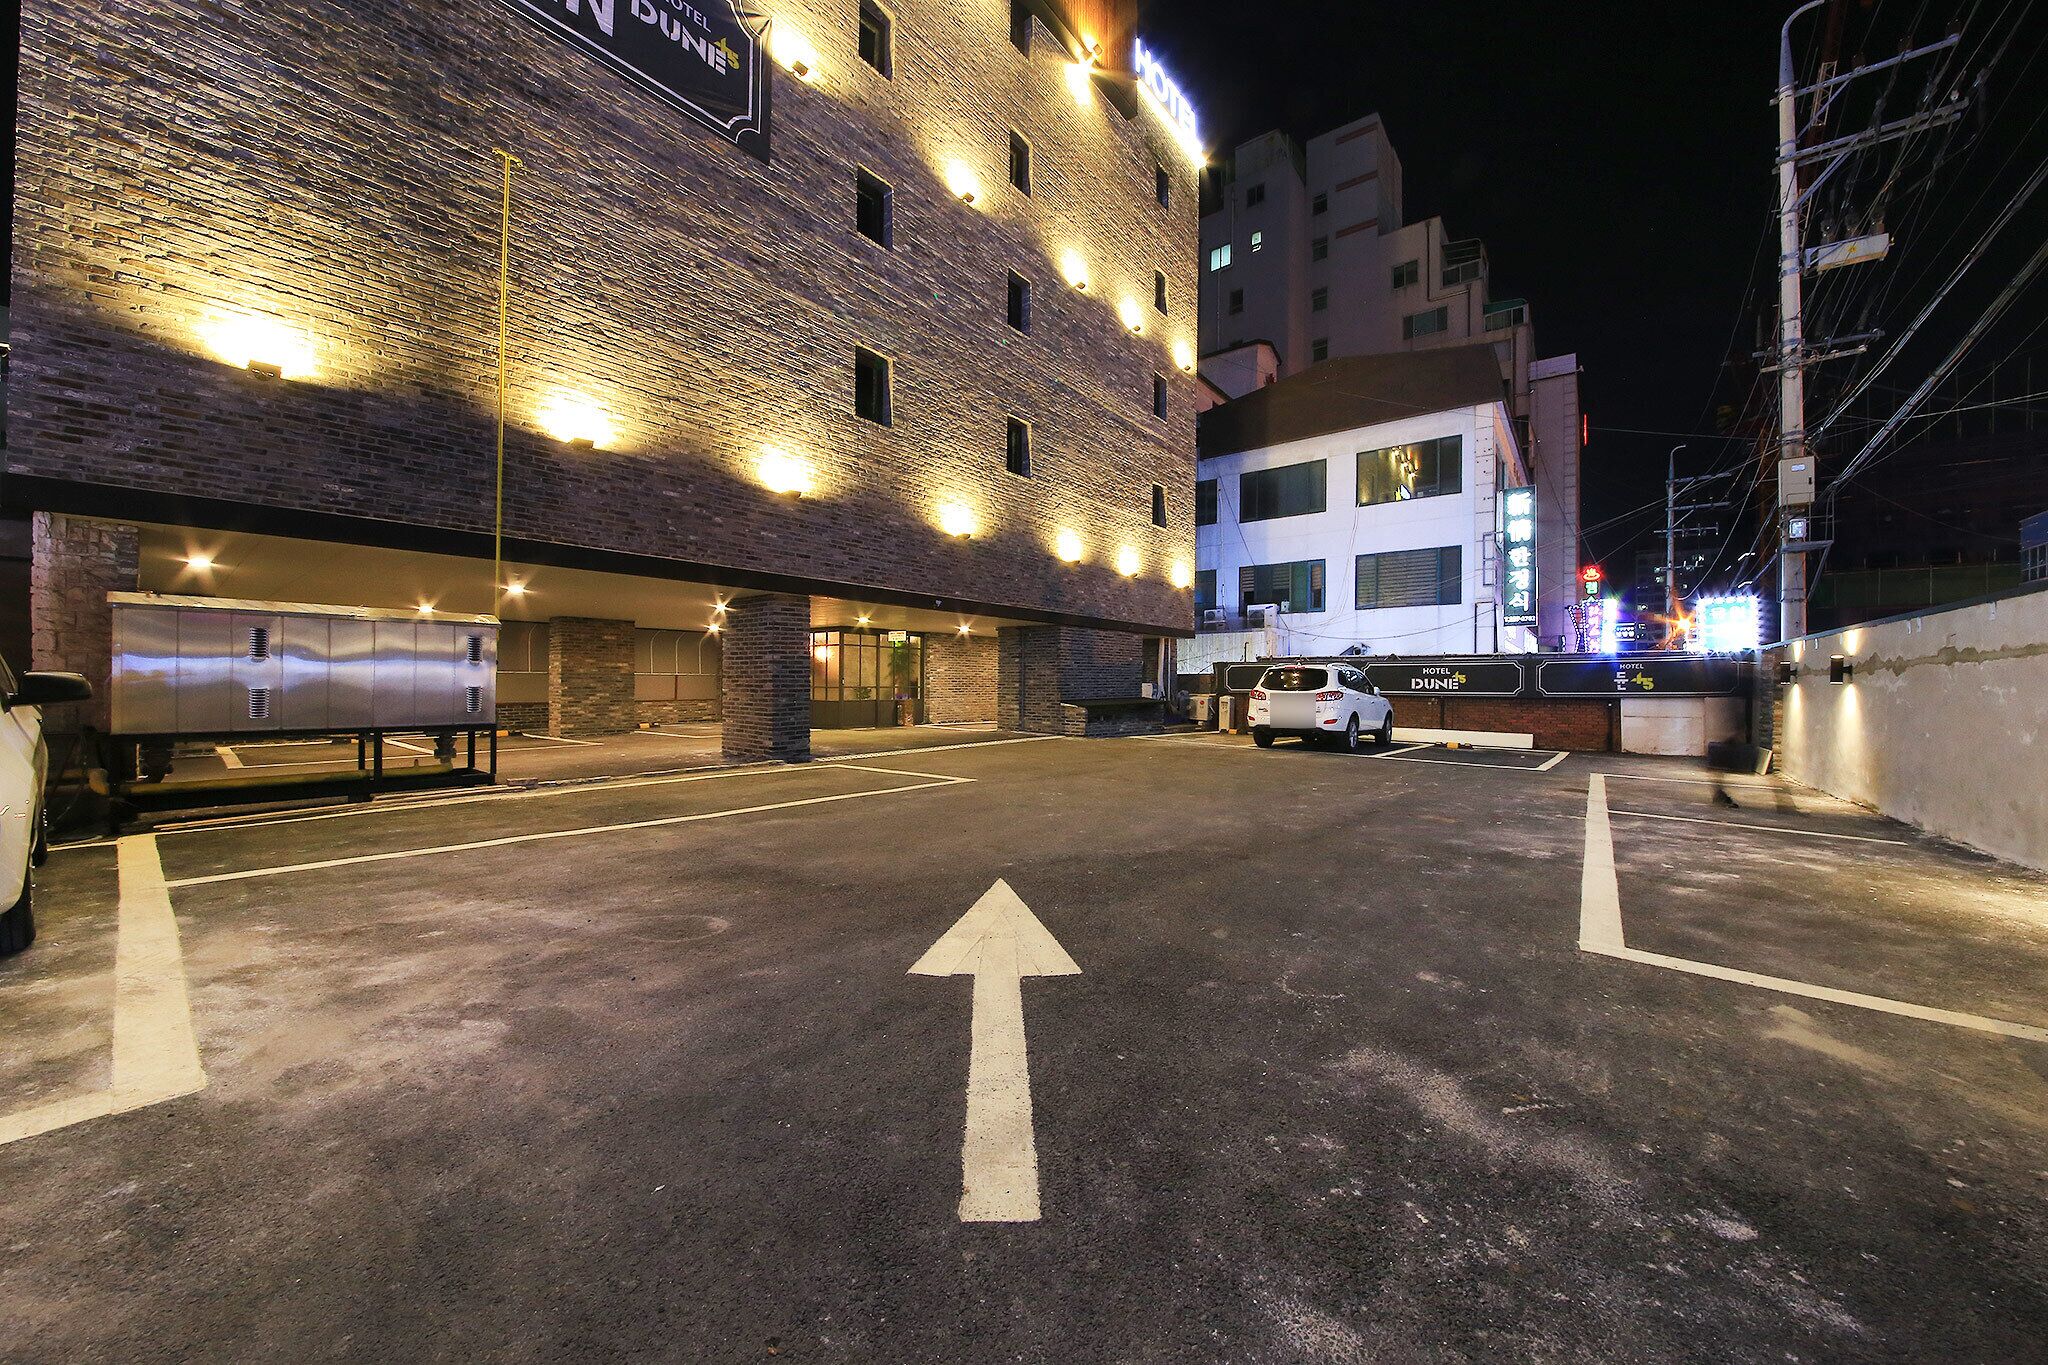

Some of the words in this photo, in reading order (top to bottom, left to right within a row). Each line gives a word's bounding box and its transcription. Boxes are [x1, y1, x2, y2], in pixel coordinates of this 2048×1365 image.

[665, 0, 712, 33] OTEL
[1422, 667, 1451, 675] HOTEL
[1411, 678, 1459, 690] DUNE
